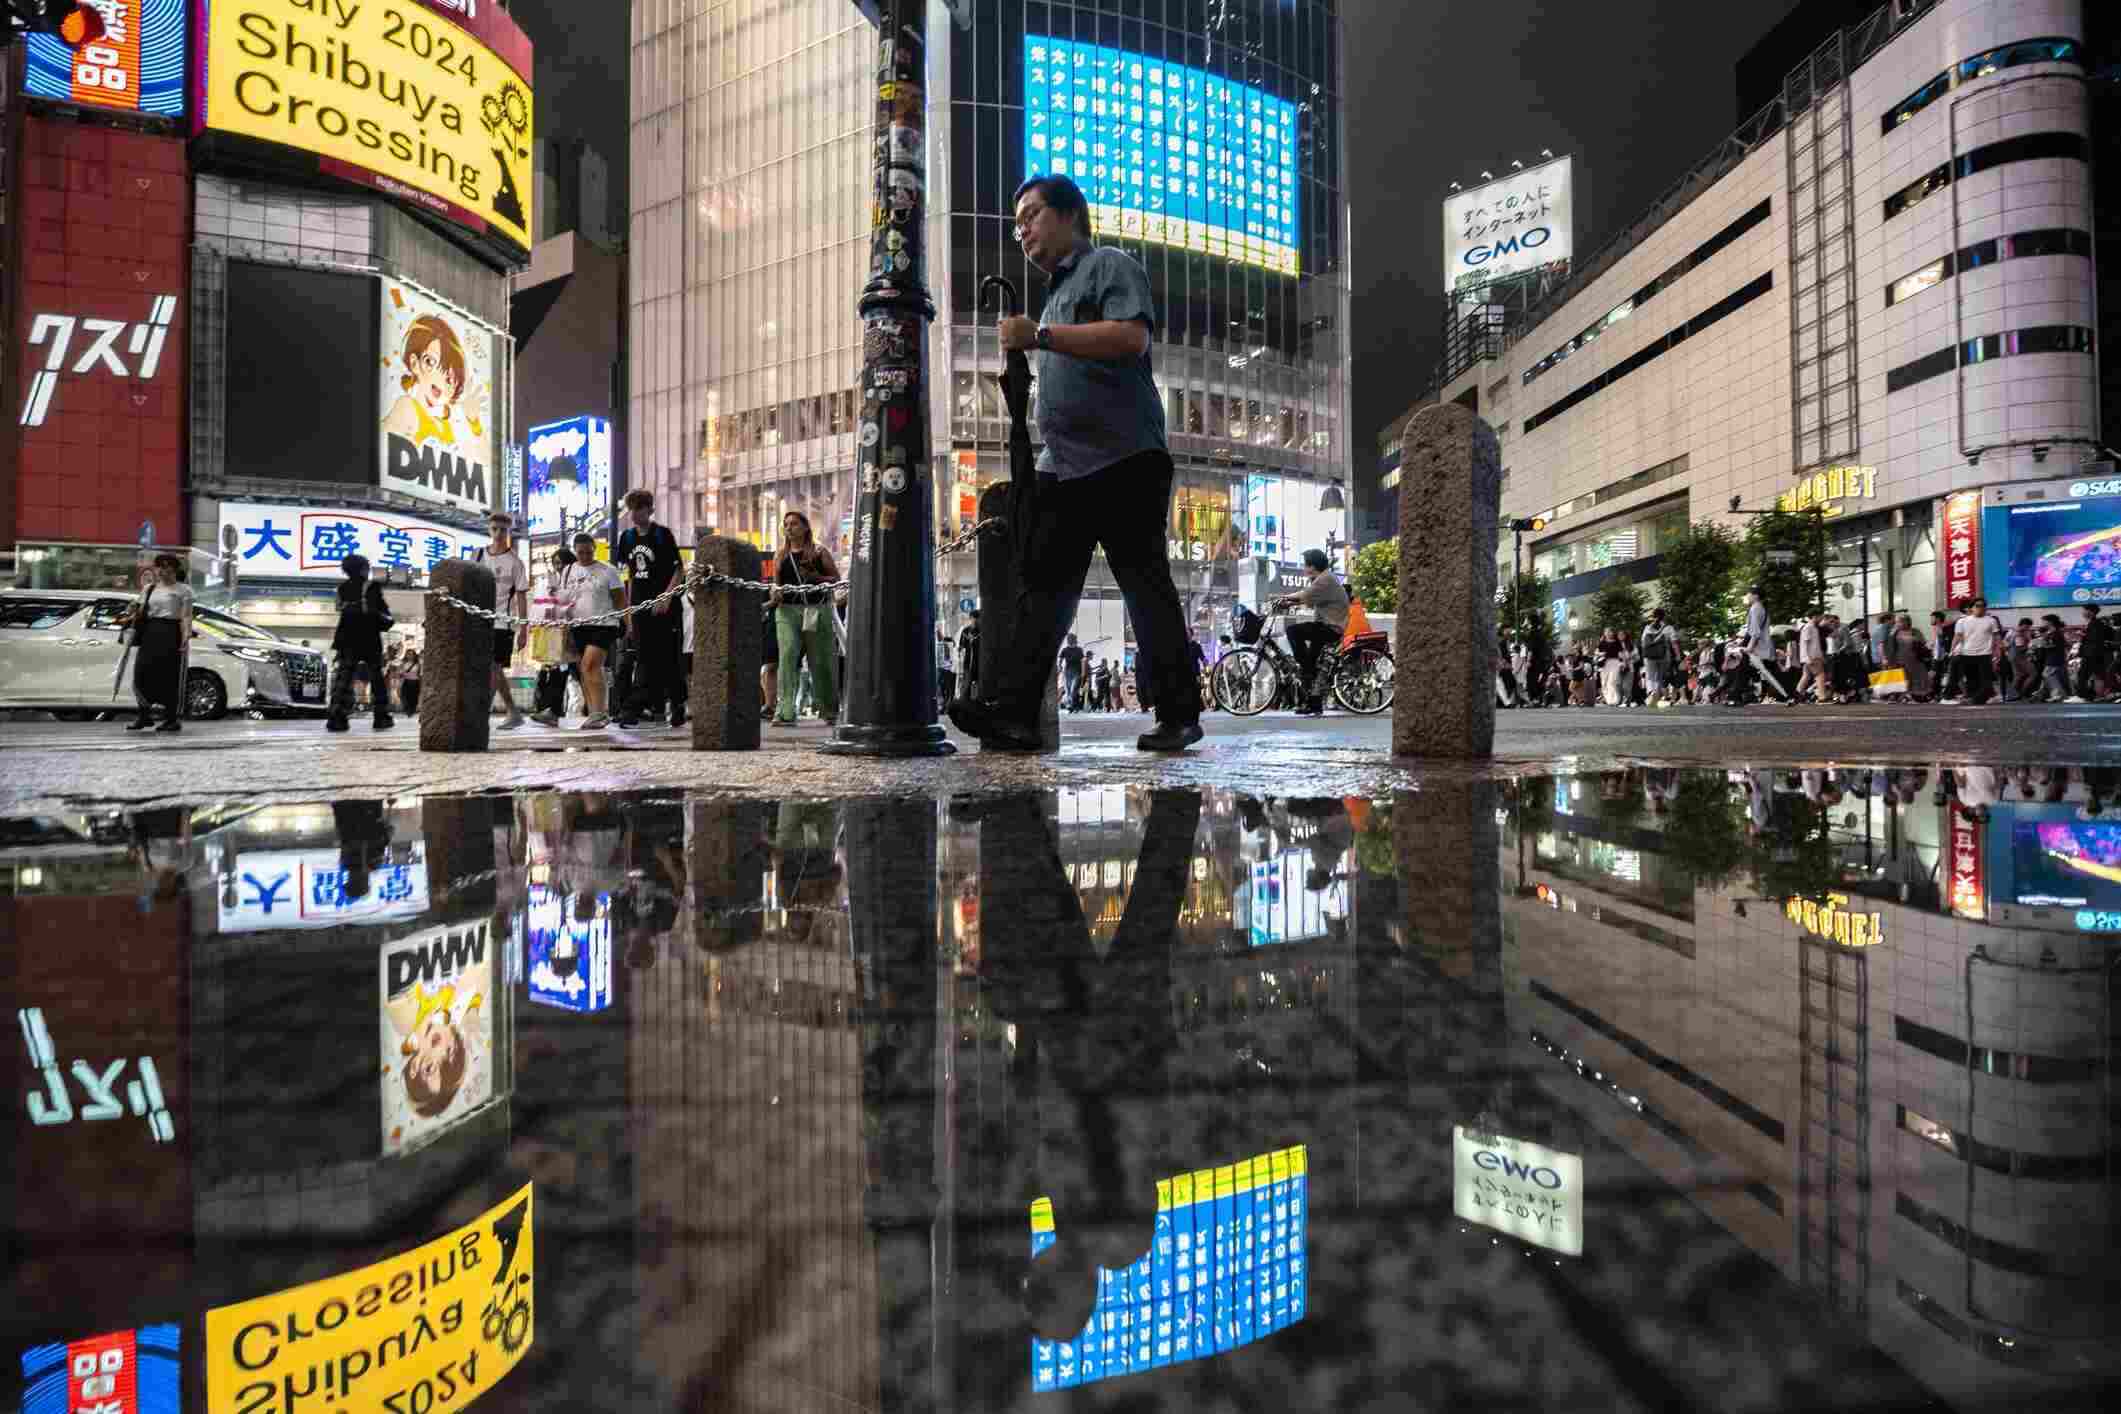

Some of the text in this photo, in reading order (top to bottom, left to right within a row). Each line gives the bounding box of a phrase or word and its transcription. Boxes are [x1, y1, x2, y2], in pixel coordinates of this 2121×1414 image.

[237, 12, 462, 134] Shibuya
[384, 9, 478, 88] 2024
[235, 71, 481, 201] Crossing
[1464, 203, 1551, 239] インターネット
[1464, 227, 1551, 265] GMO
[20, 295, 177, 426] クスリ
[387, 432, 487, 504] DMM
[243, 519, 480, 572] 大盛堂書
